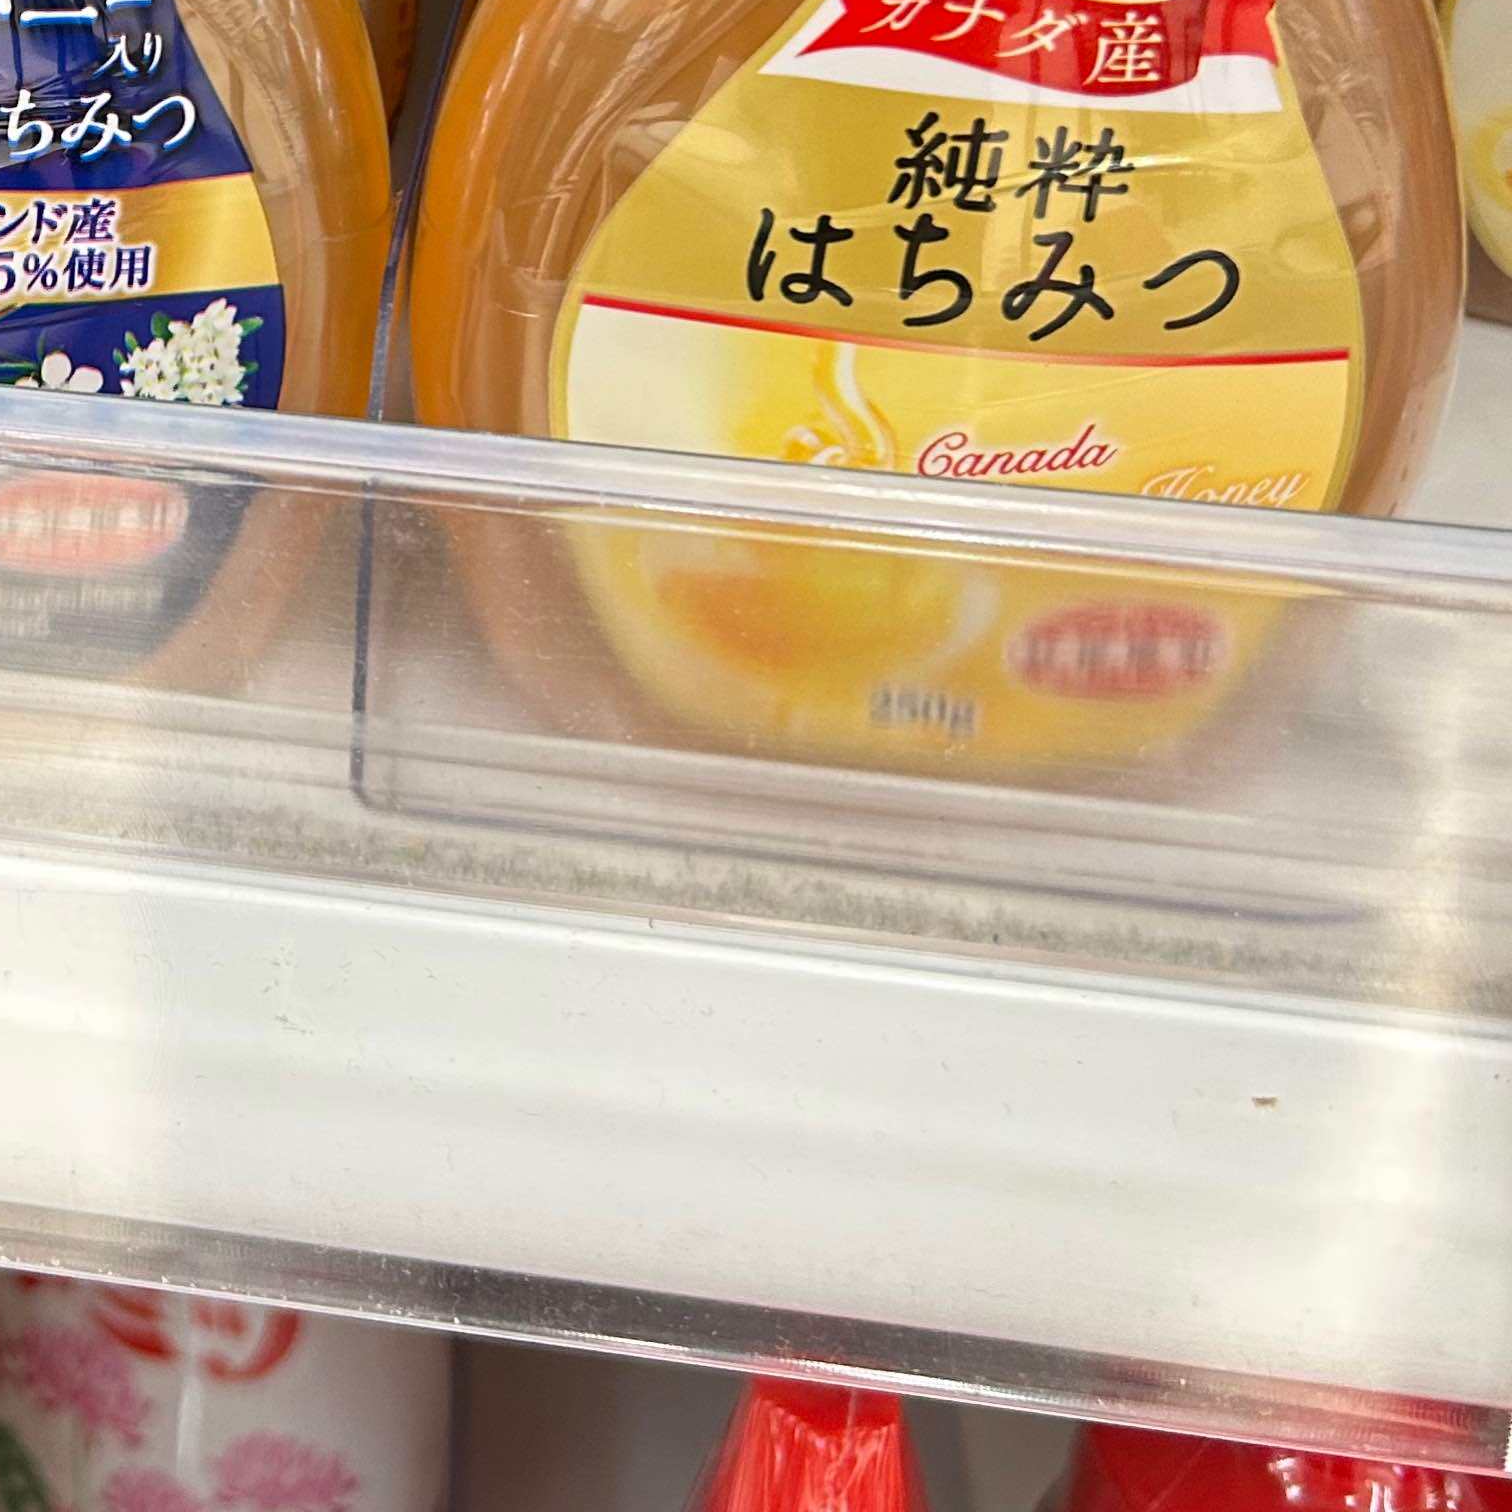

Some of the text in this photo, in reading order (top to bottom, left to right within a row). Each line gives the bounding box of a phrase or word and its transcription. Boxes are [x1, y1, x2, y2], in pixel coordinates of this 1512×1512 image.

[90, 31, 164, 80] 入り
[886, 110, 1138, 224] 純粋
[745, 207, 1242, 342] はちみつ
[916, 423, 1120, 479] Canada
